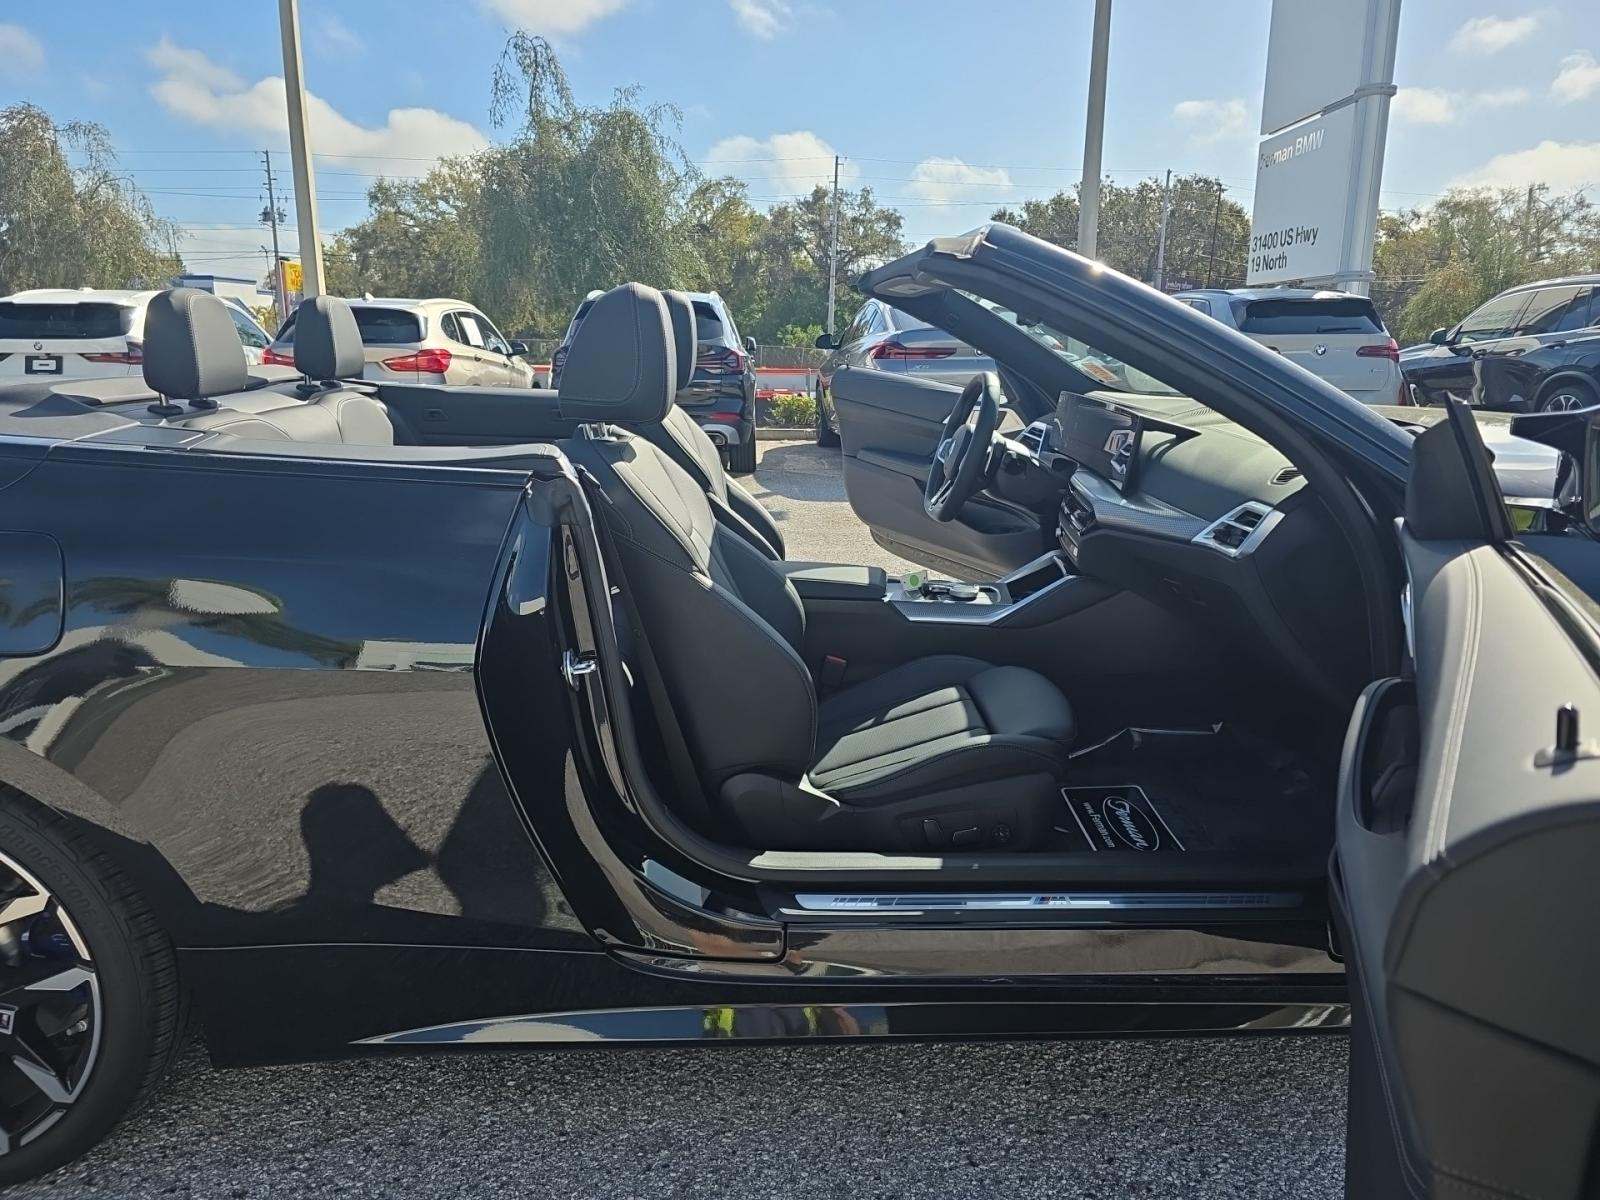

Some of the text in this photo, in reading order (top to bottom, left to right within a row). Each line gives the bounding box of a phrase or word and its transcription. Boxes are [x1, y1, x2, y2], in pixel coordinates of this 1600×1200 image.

[1295, 129, 1324, 156] BMW
[1252, 225, 1319, 252] 31400 US Hwy
[1251, 251, 1287, 272] 19 North
